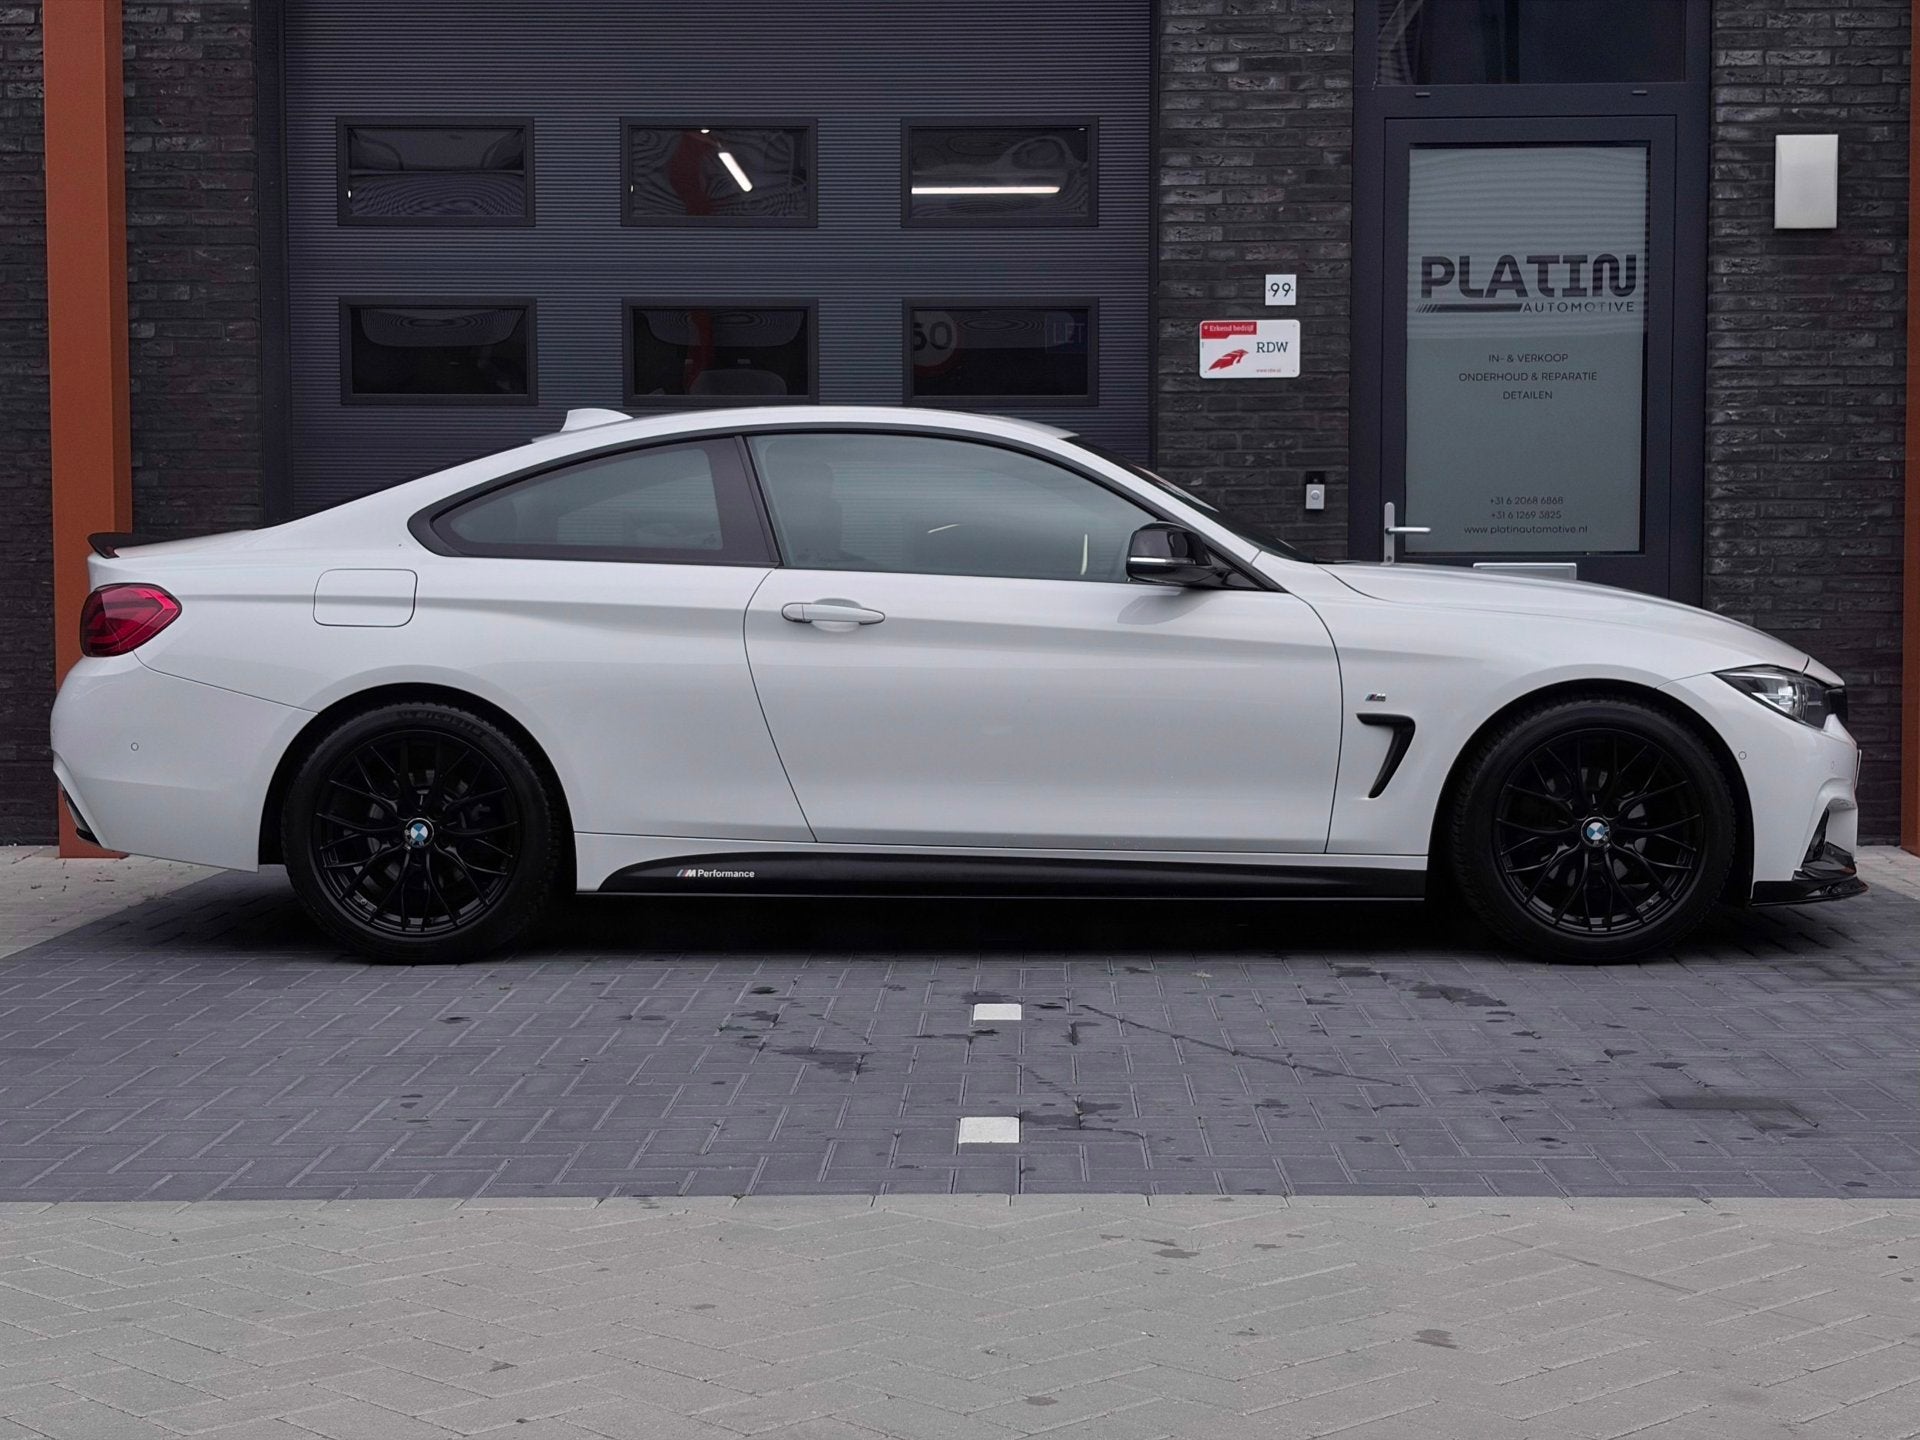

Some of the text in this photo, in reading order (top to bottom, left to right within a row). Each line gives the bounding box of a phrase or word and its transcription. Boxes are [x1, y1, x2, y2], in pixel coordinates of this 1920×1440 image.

[1421, 254, 1637, 298] PLATIN
[1270, 282, 1291, 297] 99
[1523, 302, 1634, 313] AUTOMOTIVE
[1257, 341, 1289, 353] RDW
[1488, 354, 1568, 362] IN- & VERKOOP
[1459, 372, 1597, 382] ONDERHOUD & REPARATIE
[1503, 391, 1553, 400] DETAILEN
[1463, 525, 1588, 535] www.platinautomotive.nl
[697, 869, 755, 878] Performance
